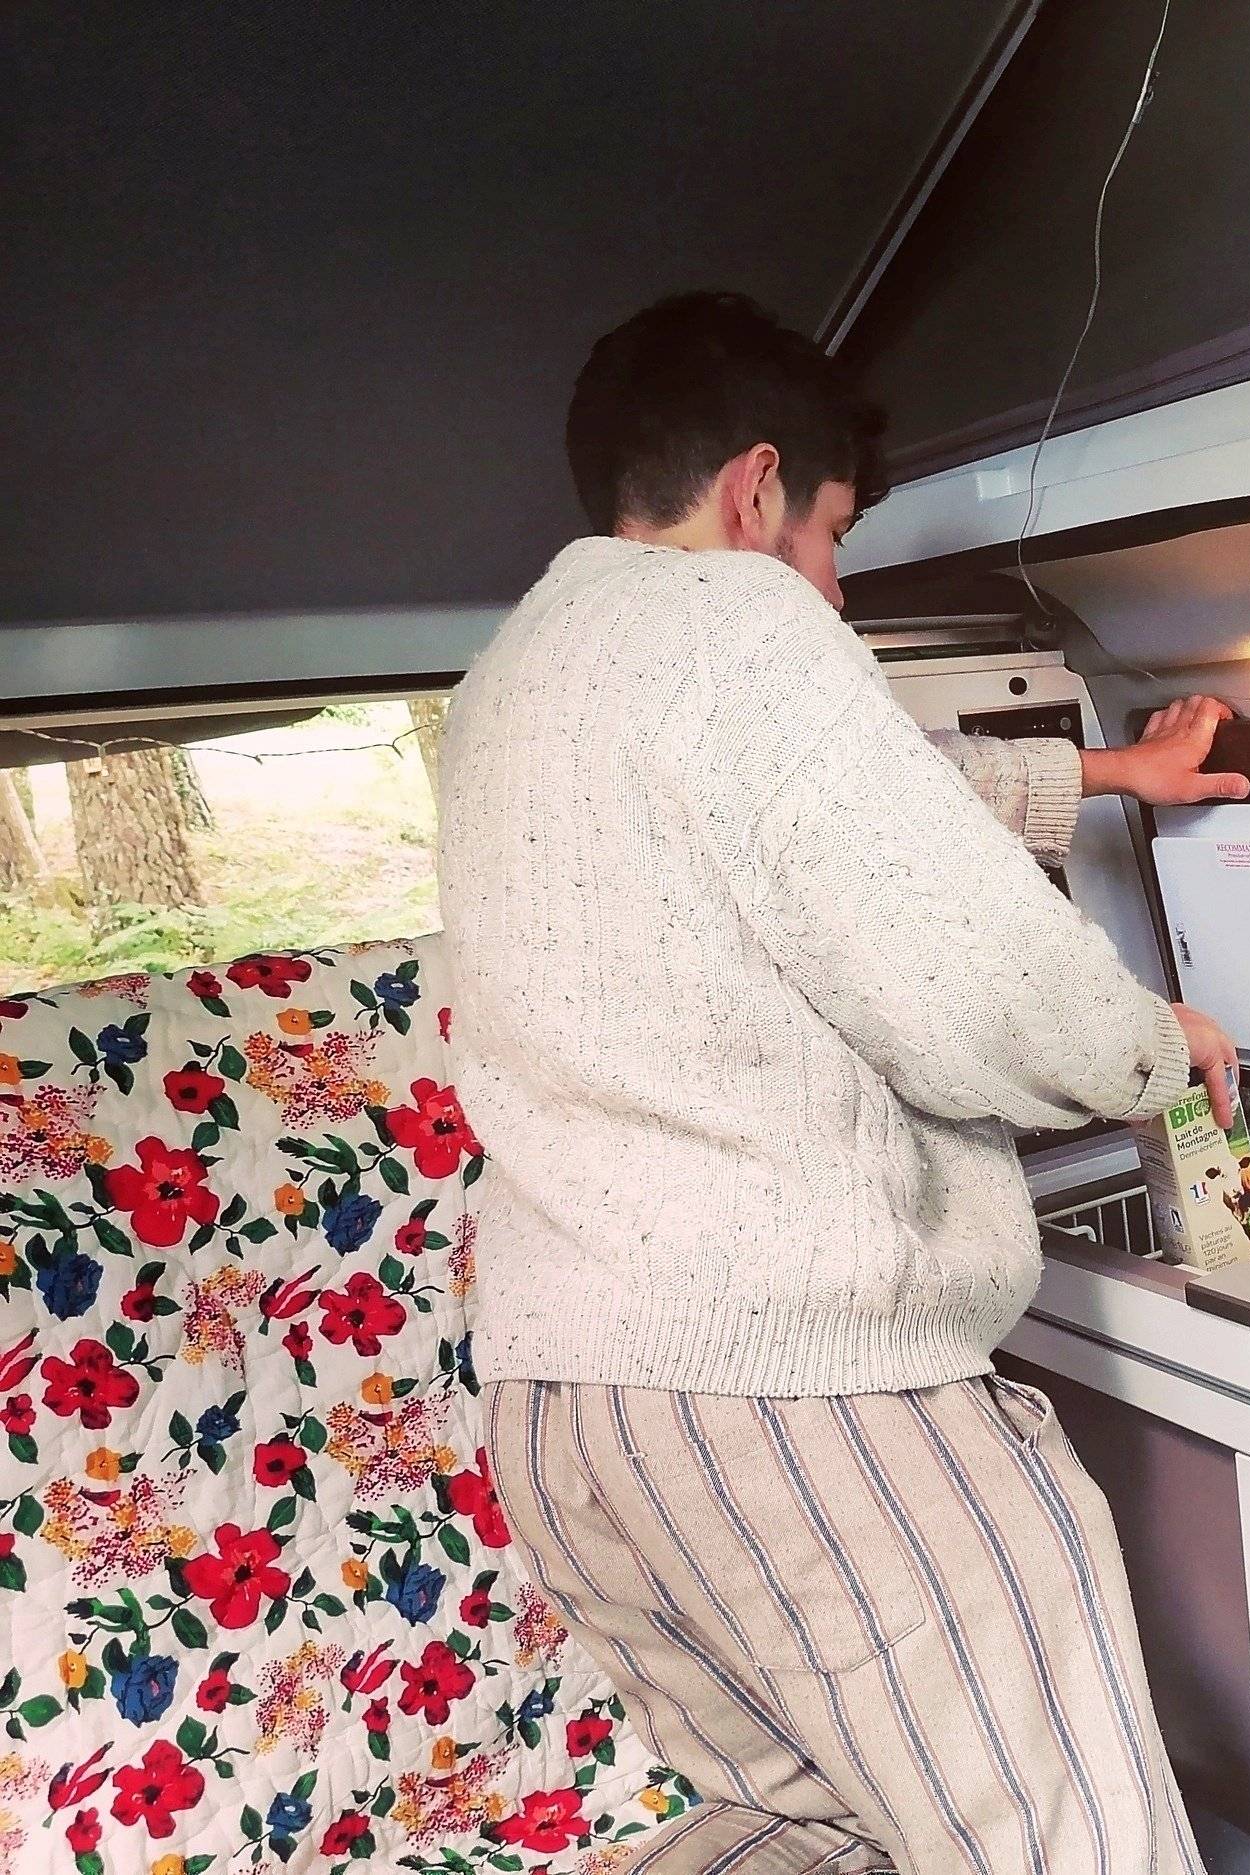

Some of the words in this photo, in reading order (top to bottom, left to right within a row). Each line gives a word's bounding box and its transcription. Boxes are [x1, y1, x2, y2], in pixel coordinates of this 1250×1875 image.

[1168, 1098, 1211, 1129] BIO
[1175, 1129, 1192, 1142] Lait
[1192, 1125, 1203, 1135] de
[1177, 1129, 1218, 1151] Montagne
[1203, 1248, 1216, 1257] 120
[1217, 1242, 1233, 1254] jours
[1205, 1257, 1216, 1266] par
[1206, 1256, 1238, 1272] minimum
